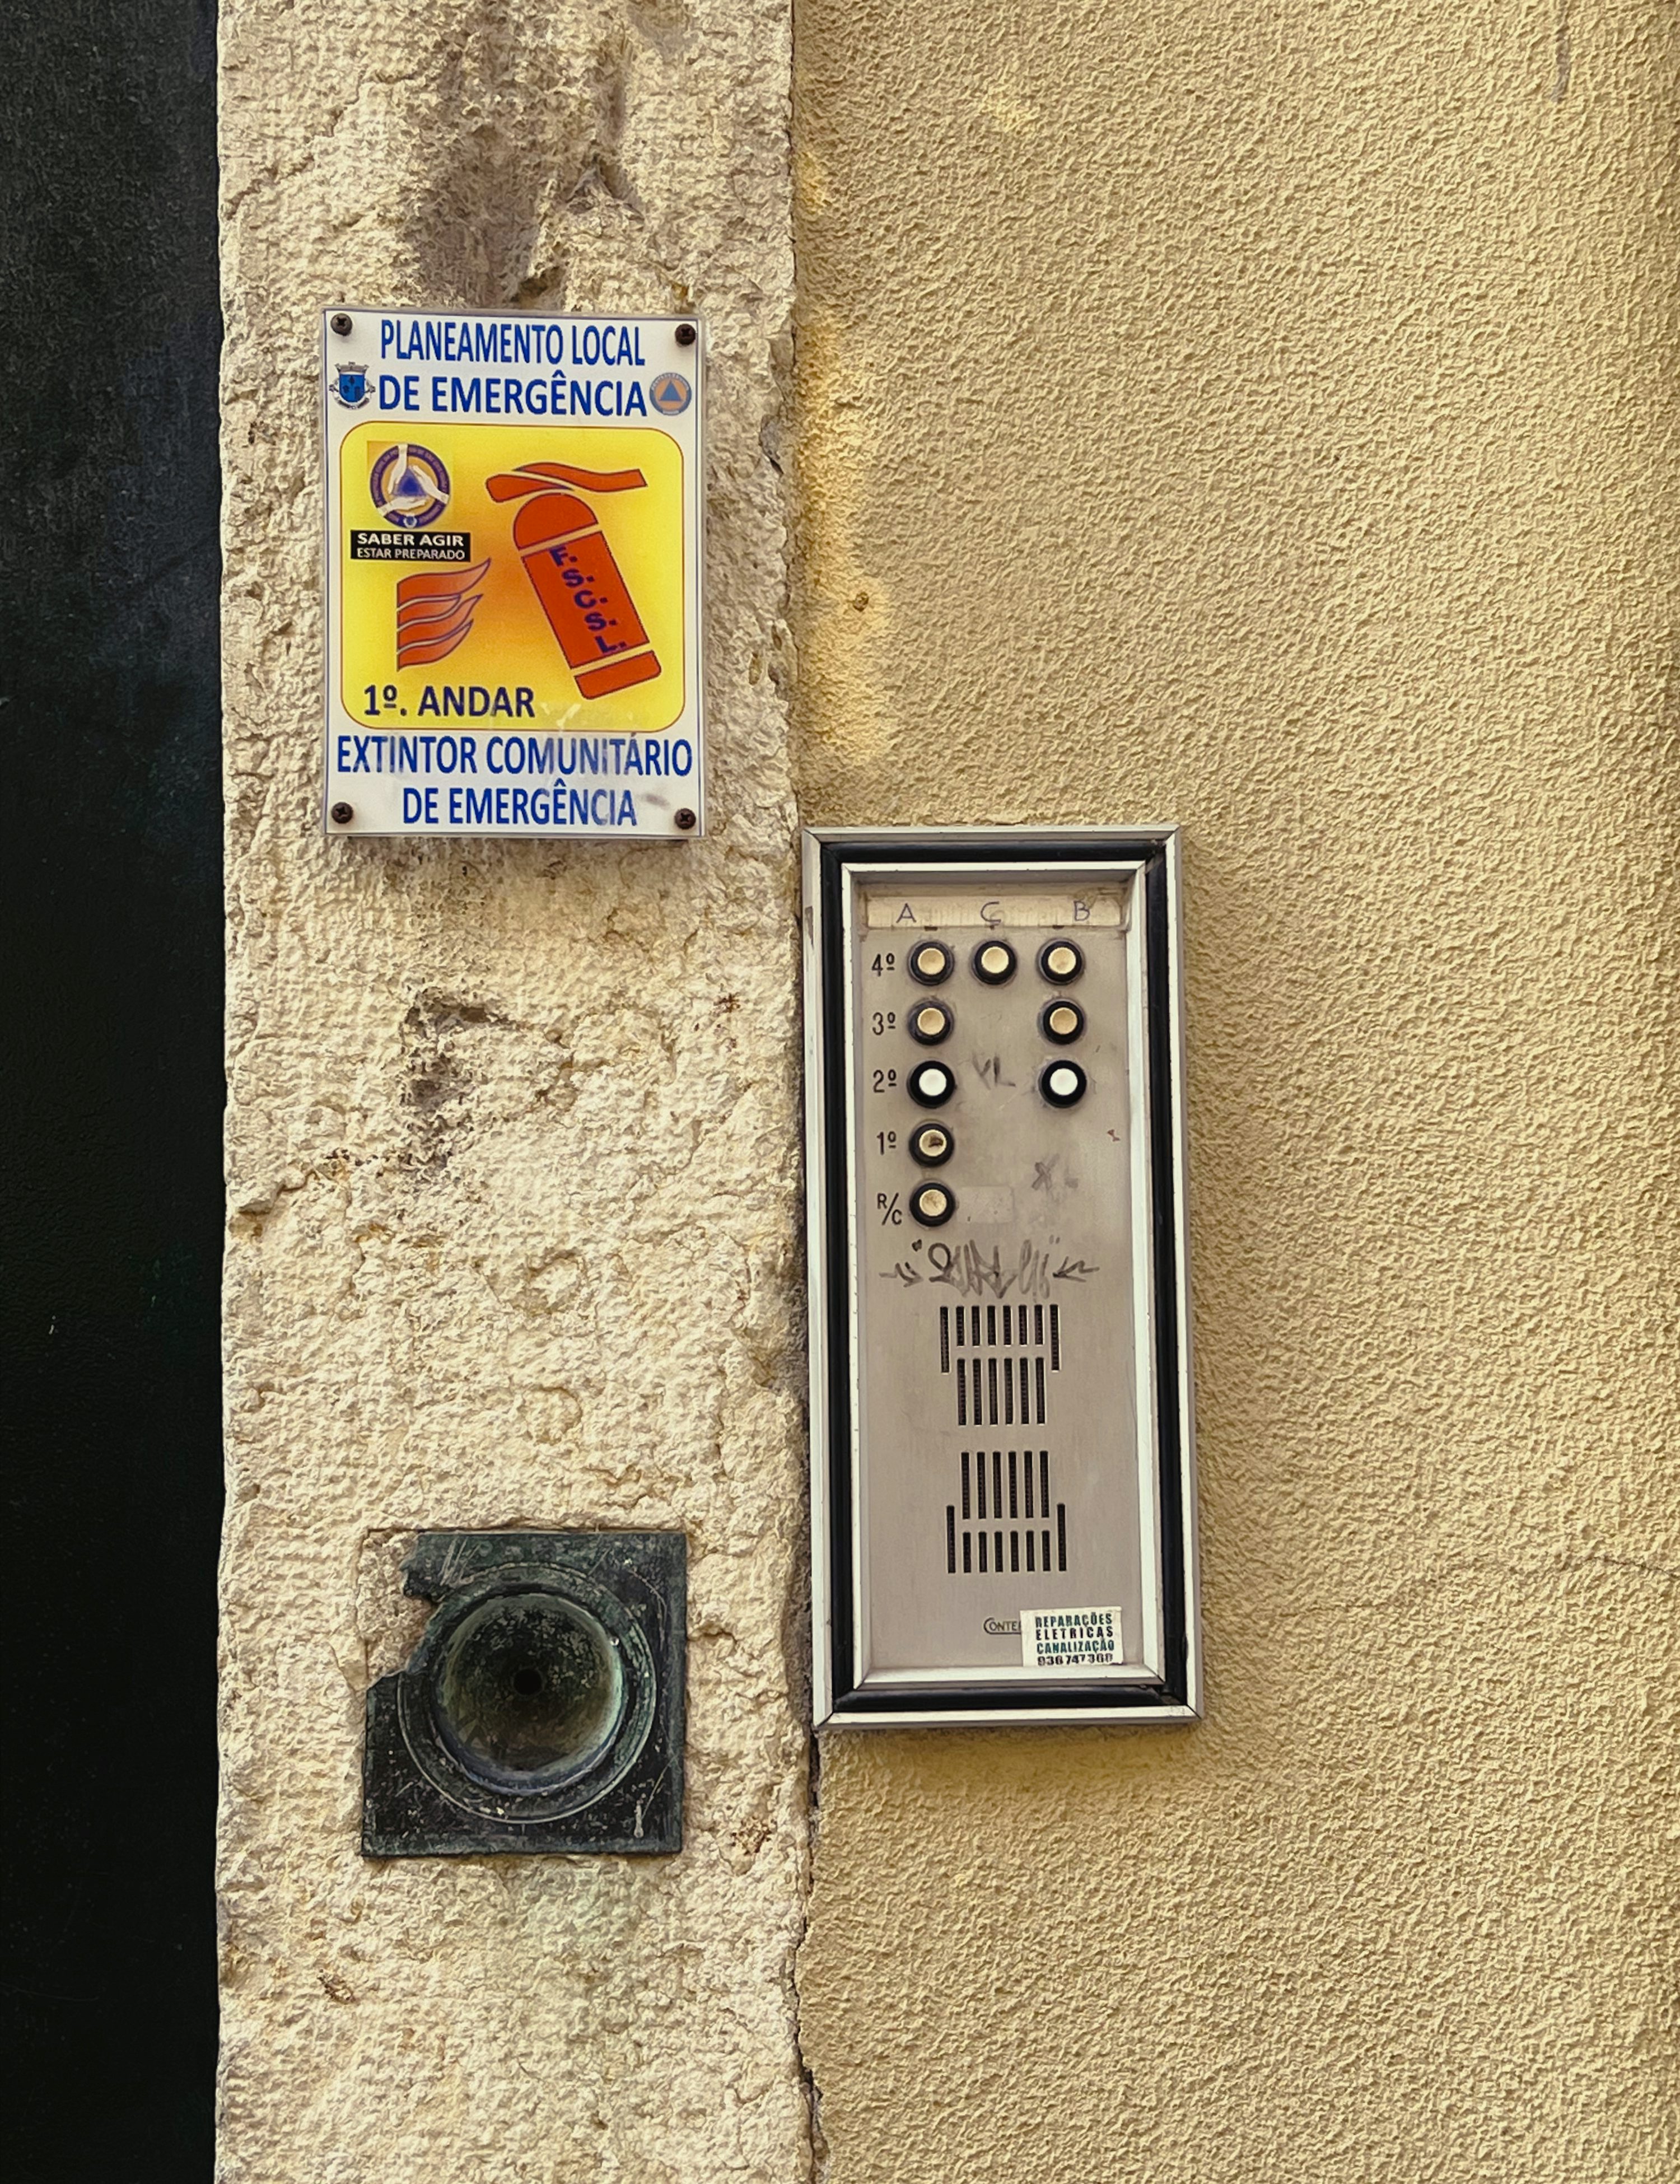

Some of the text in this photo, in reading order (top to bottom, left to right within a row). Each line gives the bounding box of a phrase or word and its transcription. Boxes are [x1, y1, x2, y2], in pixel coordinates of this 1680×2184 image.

[381, 319, 645, 366] PLANEAMENTO LOCAL
[379, 374, 419, 411] DE
[432, 369, 647, 416] EMERGÊNCIA
[357, 533, 464, 547] SABER AGIR
[357, 547, 465, 560] ESTAR PREPARADO
[417, 685, 535, 718] ANDAR
[338, 732, 692, 776] EXTINTOR COMUNITÁRIO
[403, 778, 638, 825] DE EMERGÊNCIA
[896, 903, 917, 923] A
[1074, 900, 1090, 921] B
[871, 953, 895, 977] 4º
[872, 1012, 896, 1035] 3º
[872, 1069, 897, 1093] 2º
[876, 1131, 897, 1155] 1º
[877, 1192, 903, 1225] R/C
[1036, 1626, 1113, 1641] ELETRICAS
[1037, 1639, 1114, 1654] CANALIZAÇÃO
